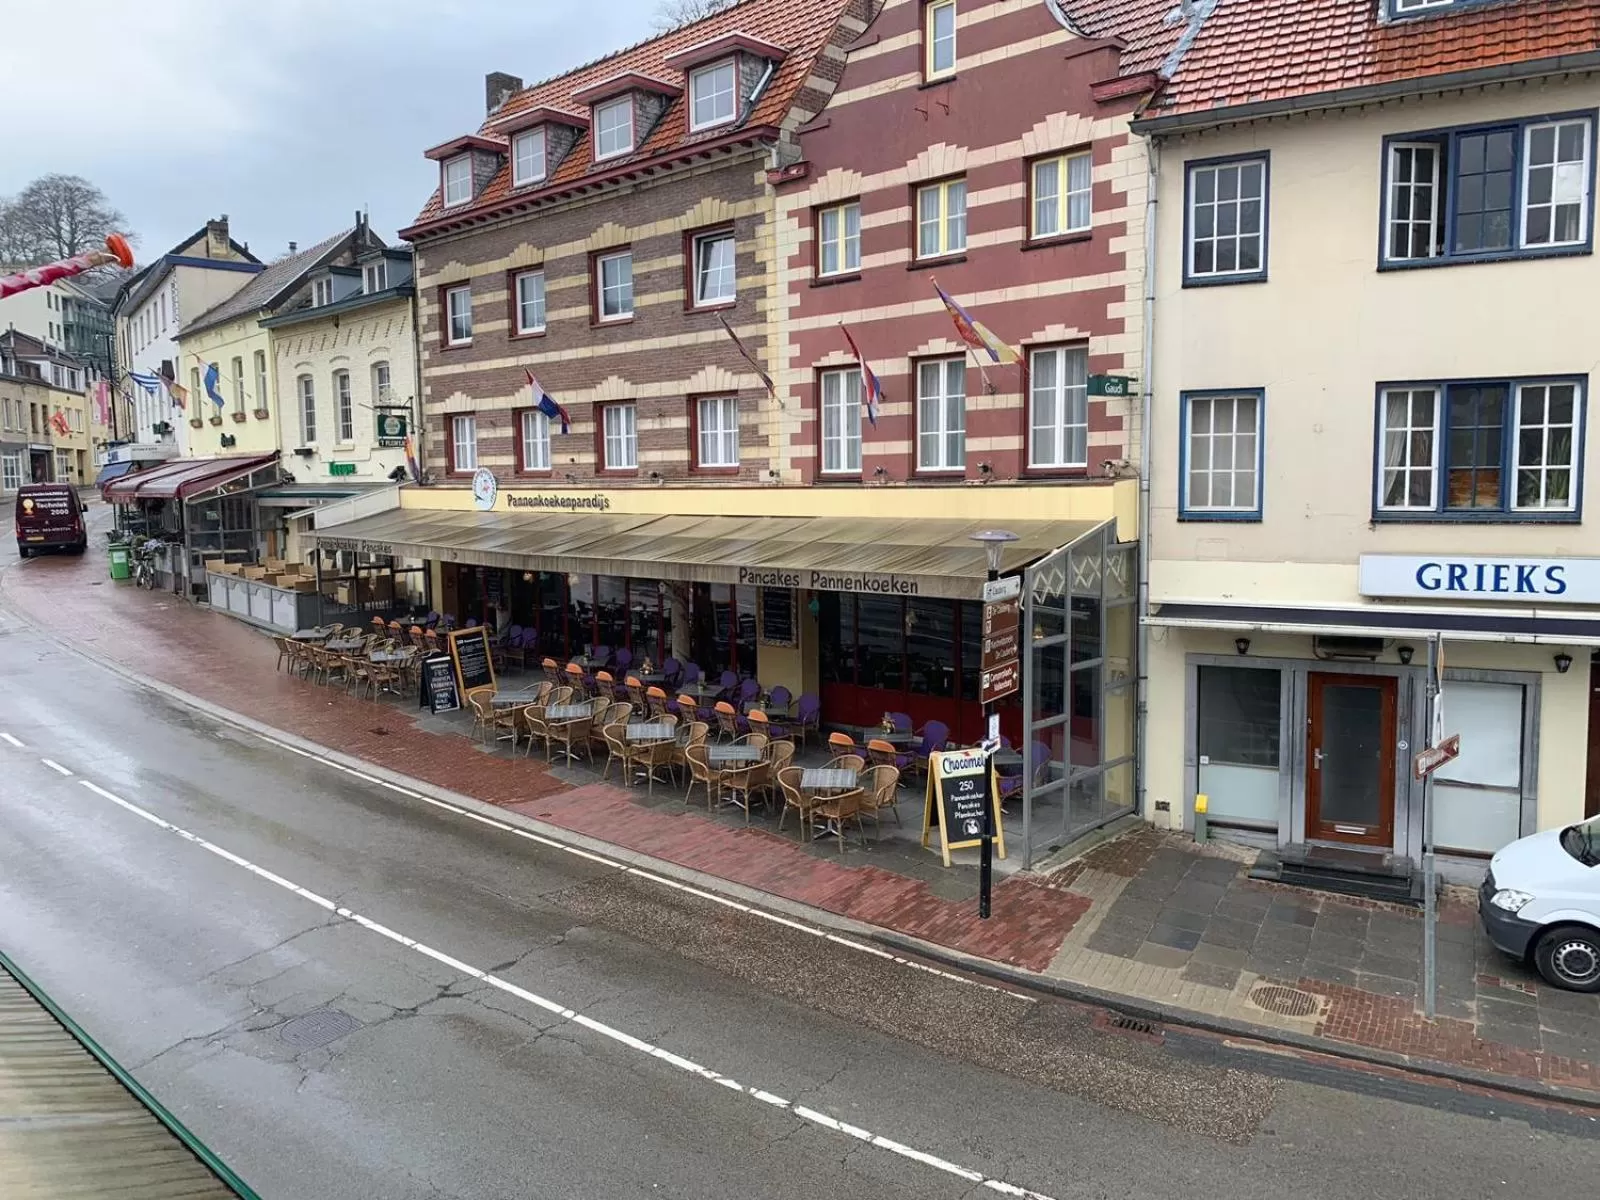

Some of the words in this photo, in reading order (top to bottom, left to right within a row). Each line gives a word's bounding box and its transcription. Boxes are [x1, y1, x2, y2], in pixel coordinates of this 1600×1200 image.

[507, 493, 610, 511] Pannenkoekenparadijs
[739, 567, 800, 586] Pancakes
[810, 570, 919, 594] Pannenkoeken
[1415, 562, 1567, 595] GRIEKS
[943, 755, 985, 774] Chocomel
[959, 780, 973, 790] 250
